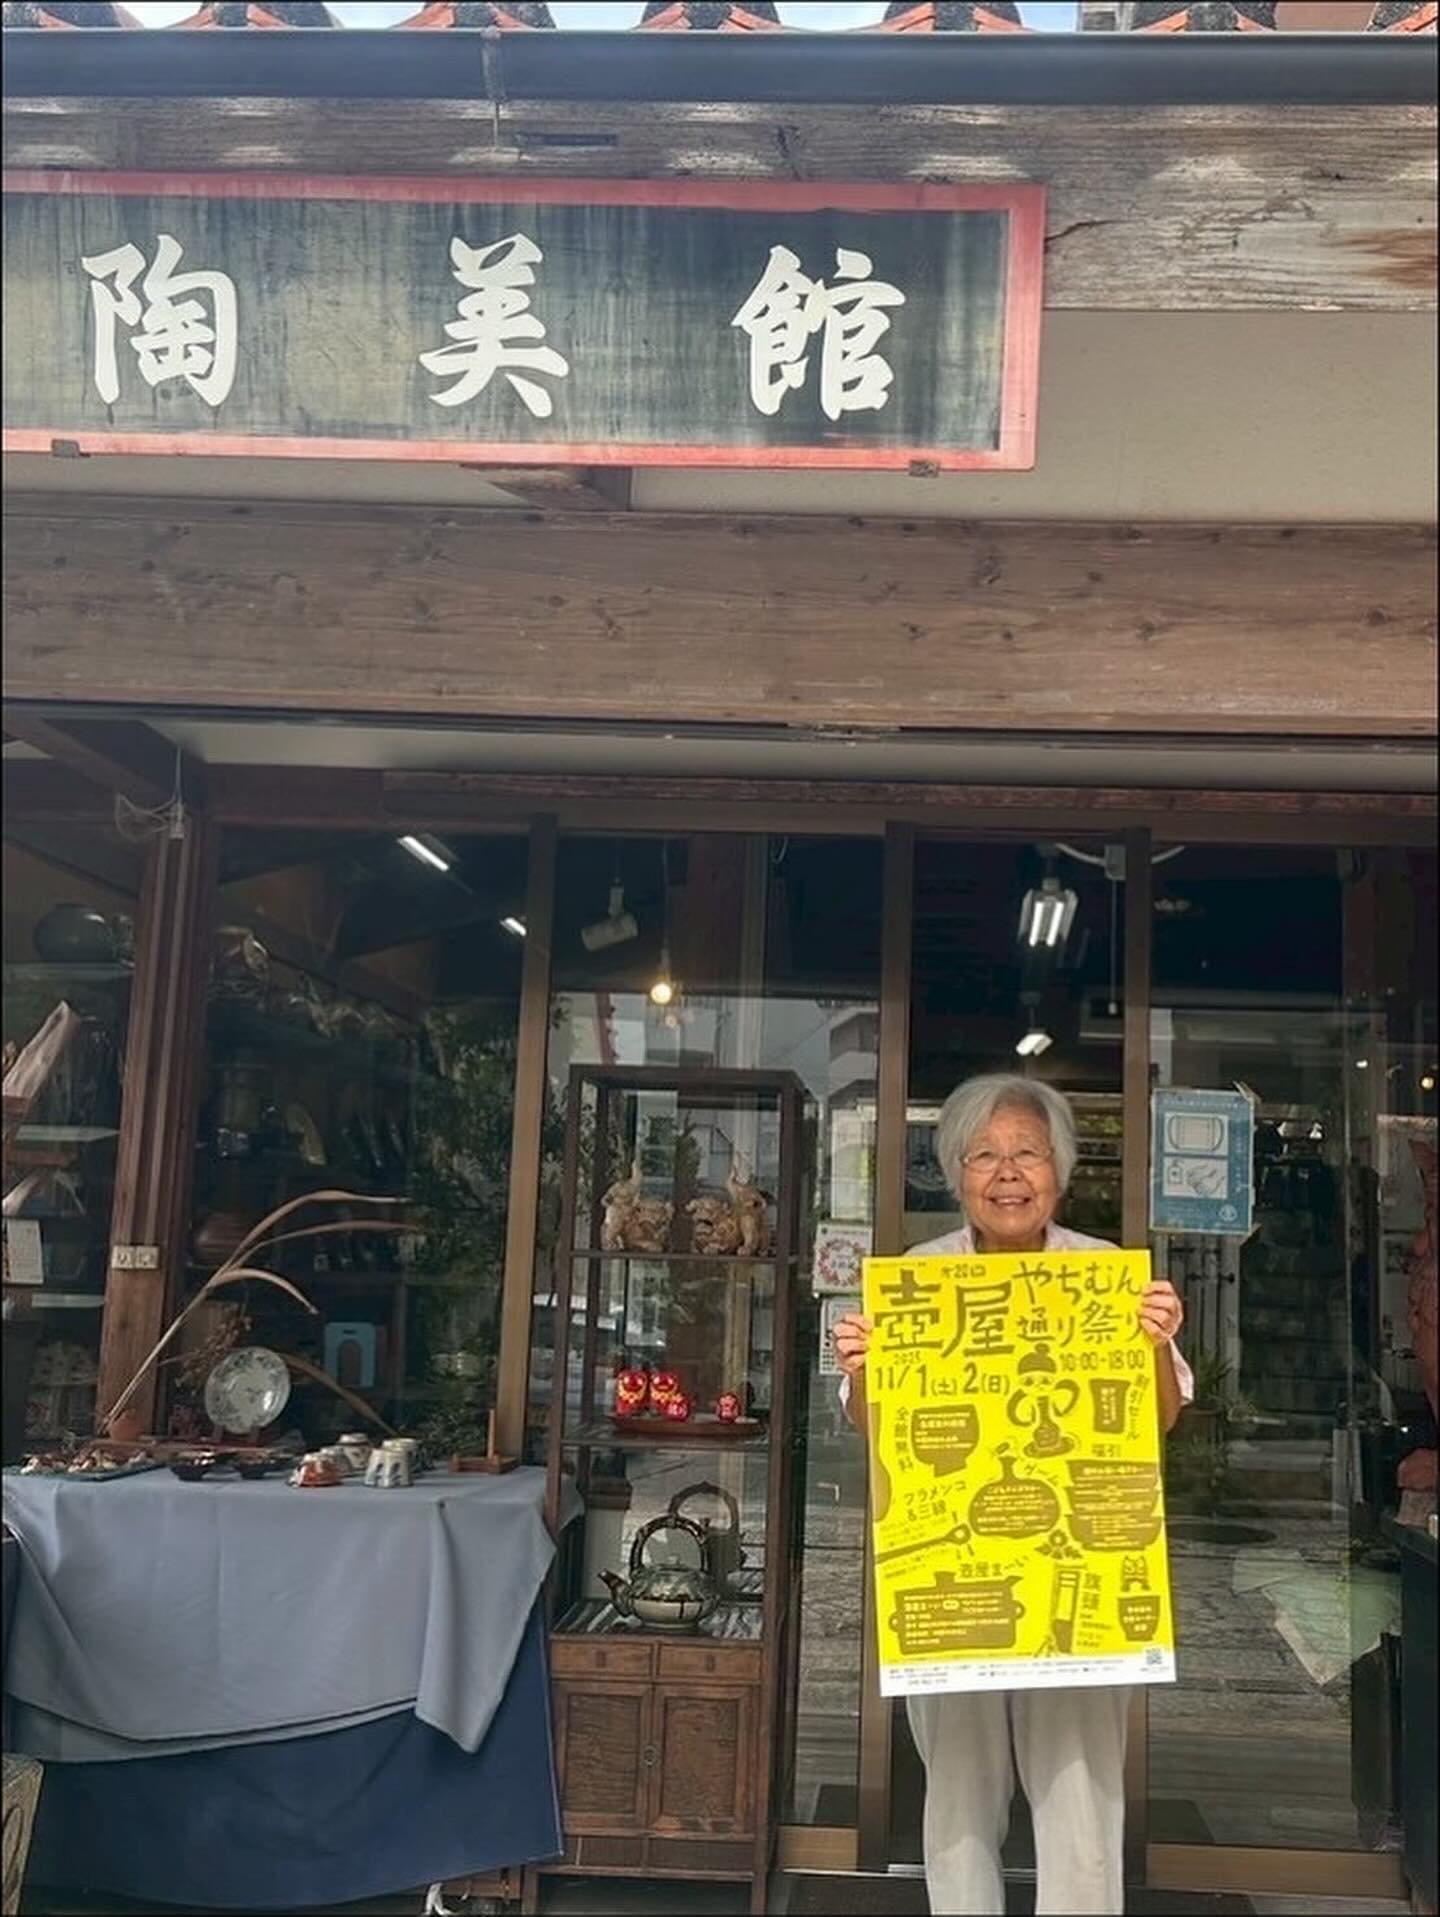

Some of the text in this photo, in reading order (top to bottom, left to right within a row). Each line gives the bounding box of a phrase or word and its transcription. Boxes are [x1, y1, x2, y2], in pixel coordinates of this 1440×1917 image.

[81, 232, 906, 421] 陶美館
[1012, 1260, 1142, 1305] やちむん
[1016, 1300, 1141, 1348] 通り祭り
